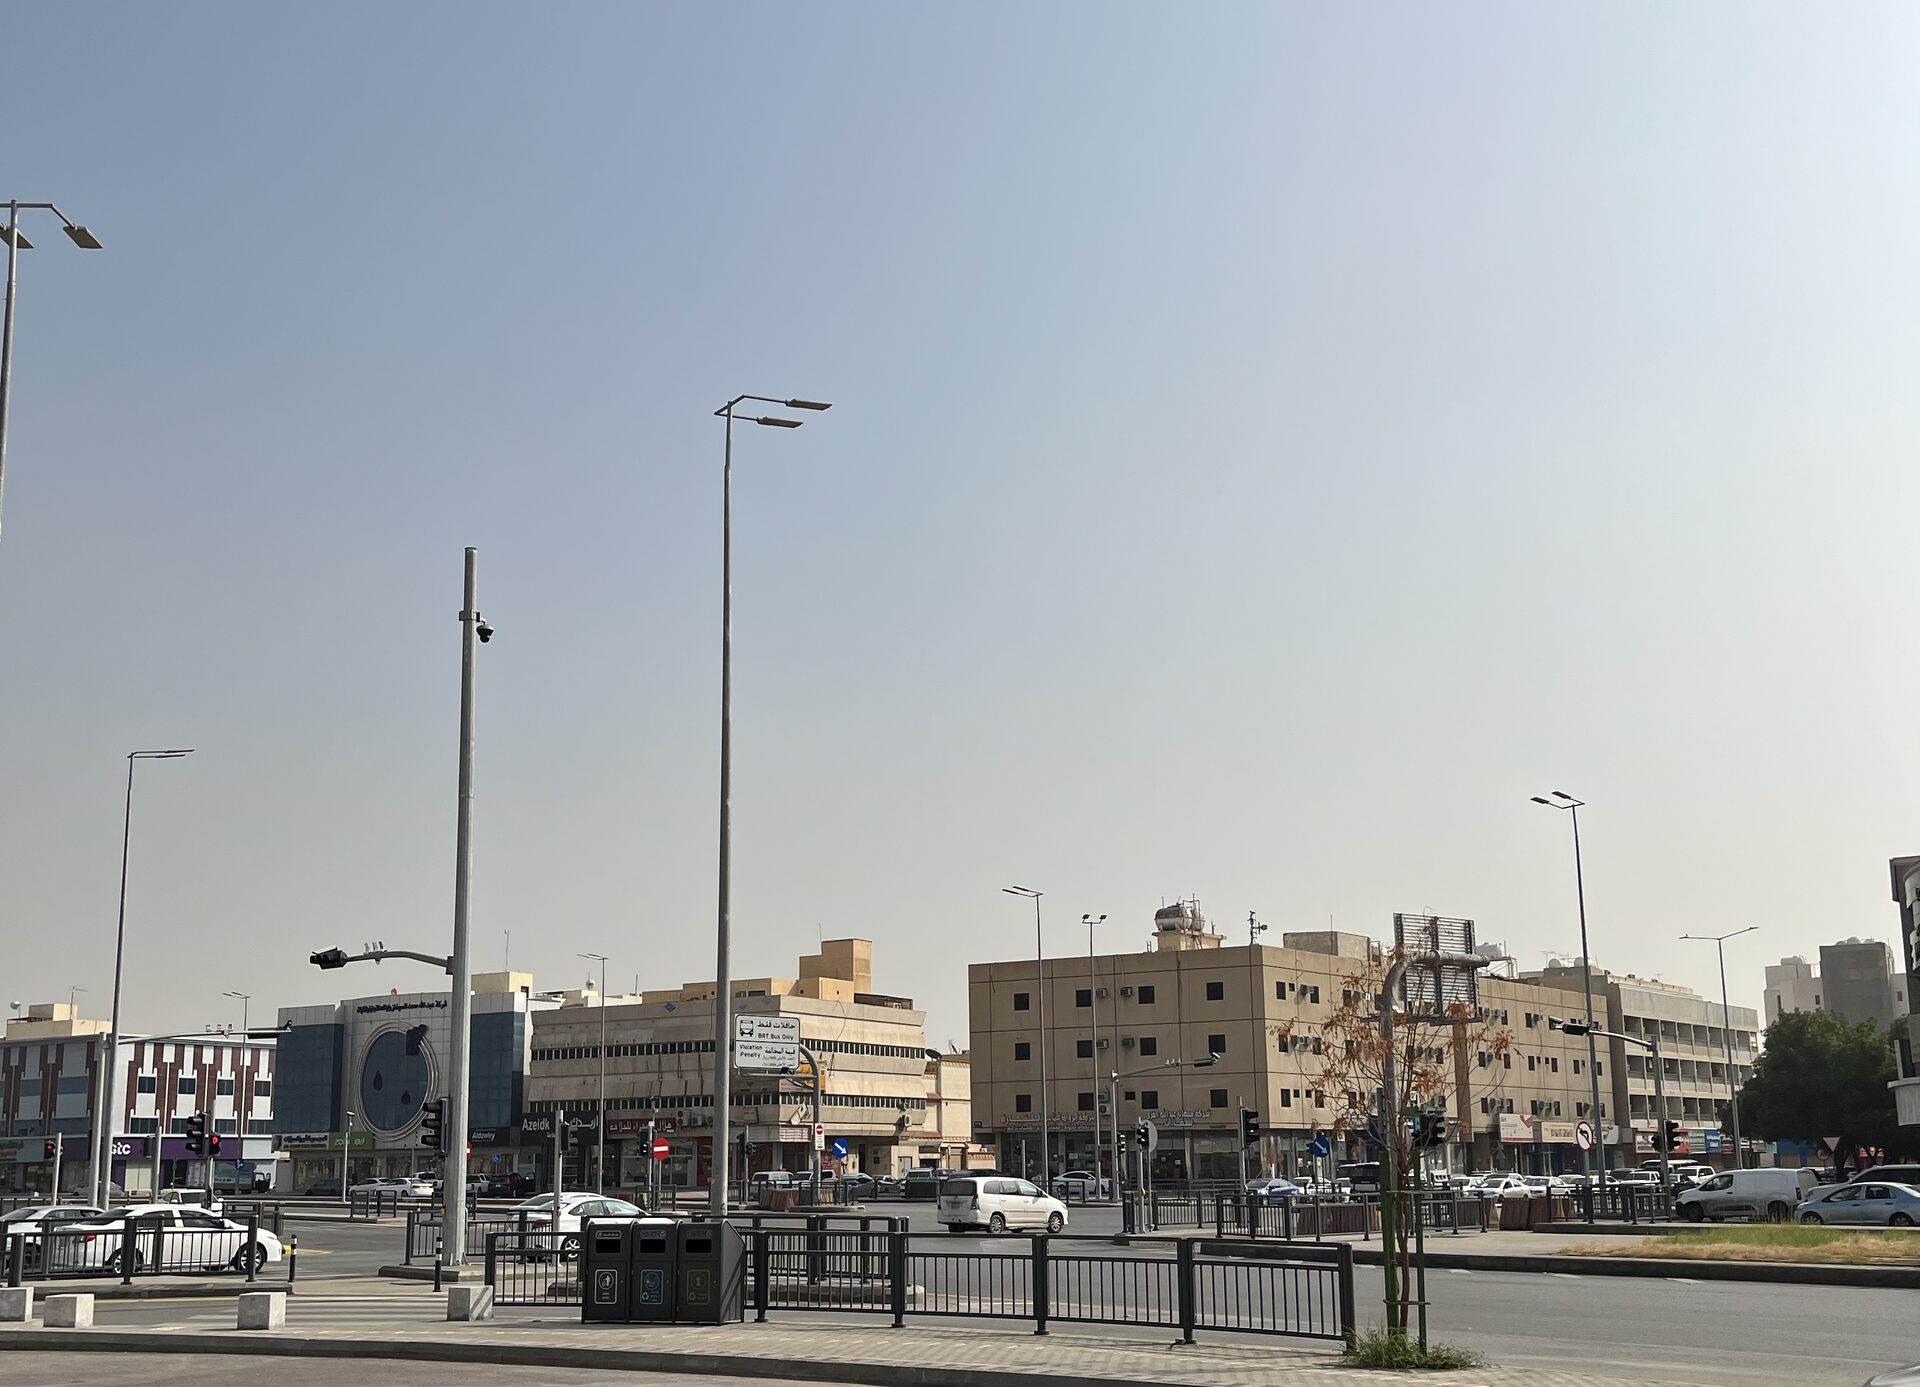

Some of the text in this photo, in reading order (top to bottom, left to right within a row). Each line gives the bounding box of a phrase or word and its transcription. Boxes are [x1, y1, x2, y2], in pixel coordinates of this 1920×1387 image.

[757, 1020, 795, 1029] حافلات فقط
[785, 1047, 796, 1057] قيمة
